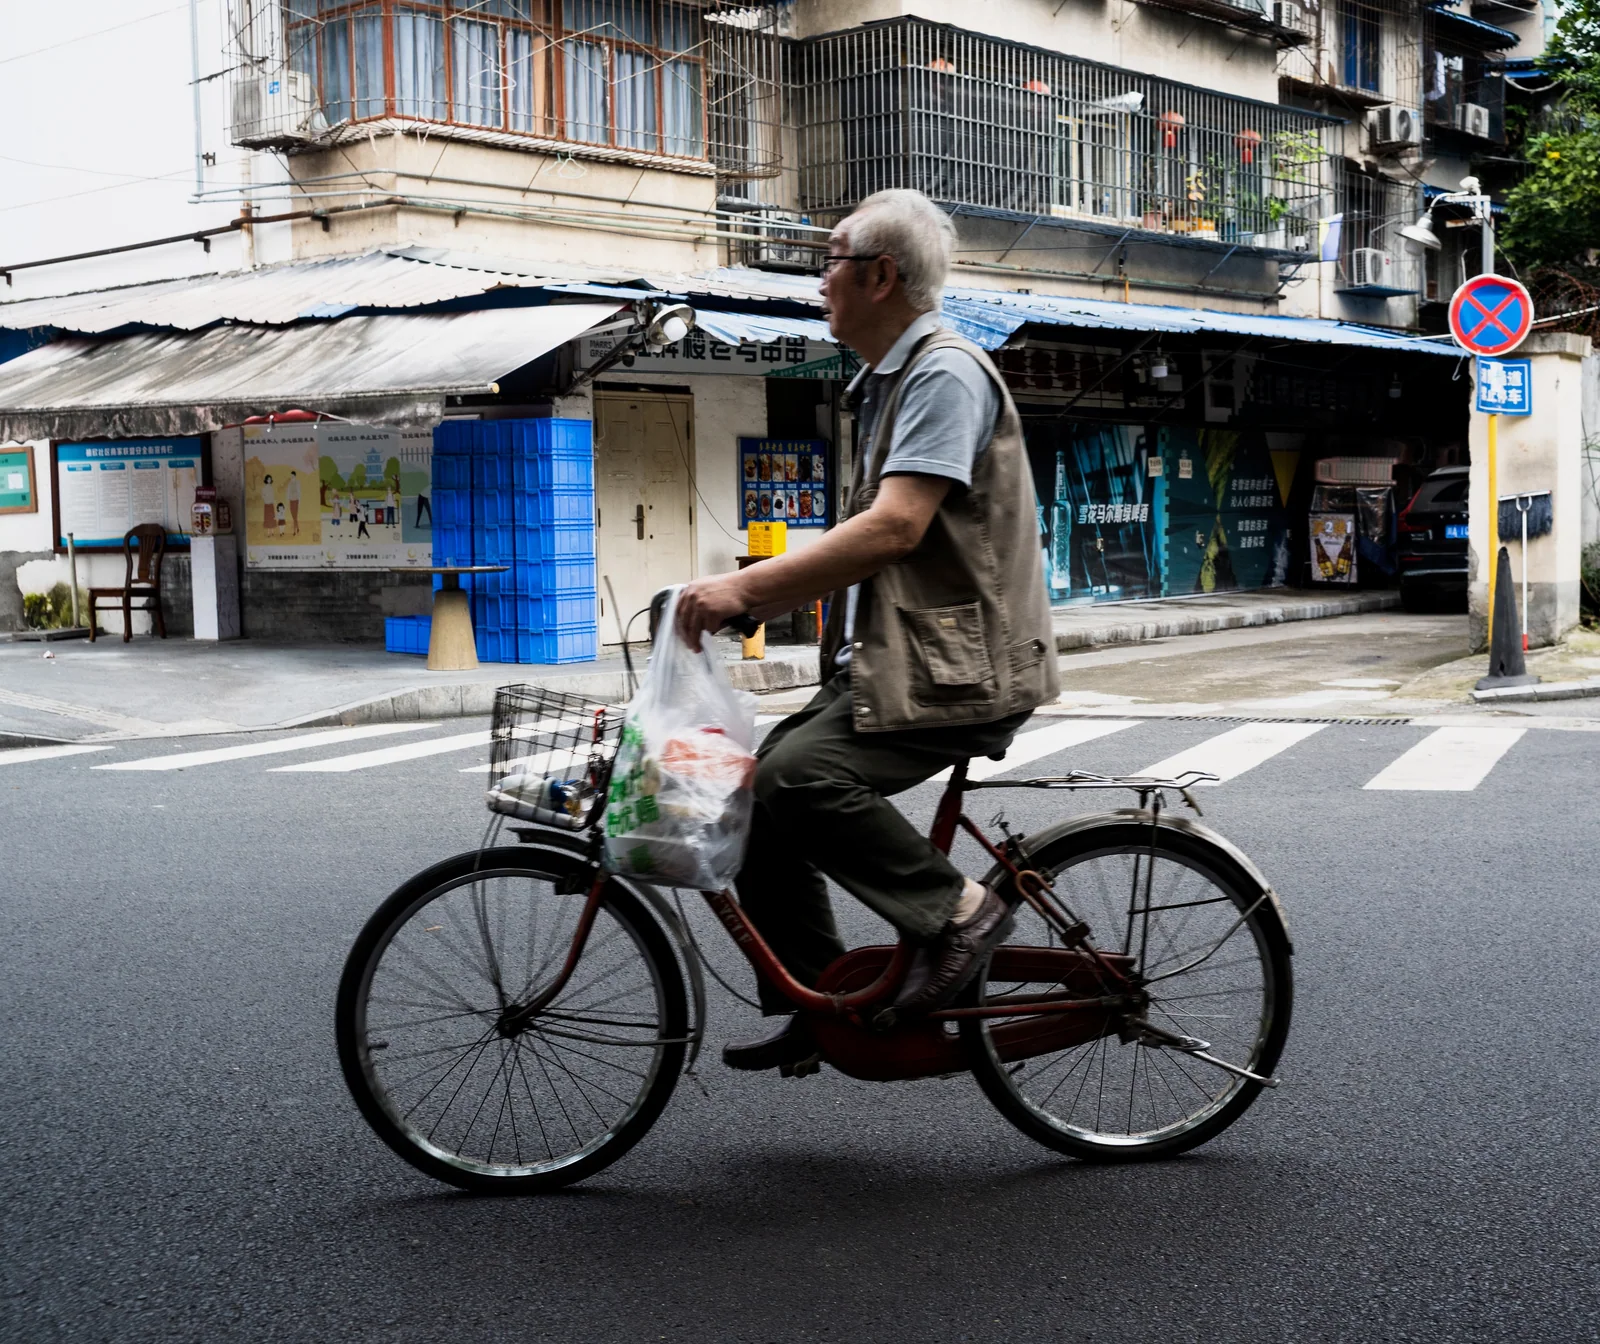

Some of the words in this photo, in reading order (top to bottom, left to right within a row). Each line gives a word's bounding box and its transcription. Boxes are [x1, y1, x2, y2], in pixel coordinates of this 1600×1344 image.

[590, 340, 612, 350] MARRS
[590, 349, 611, 358] GREE
[1078, 503, 1149, 524] 雪花马尔斯绿啤酒
